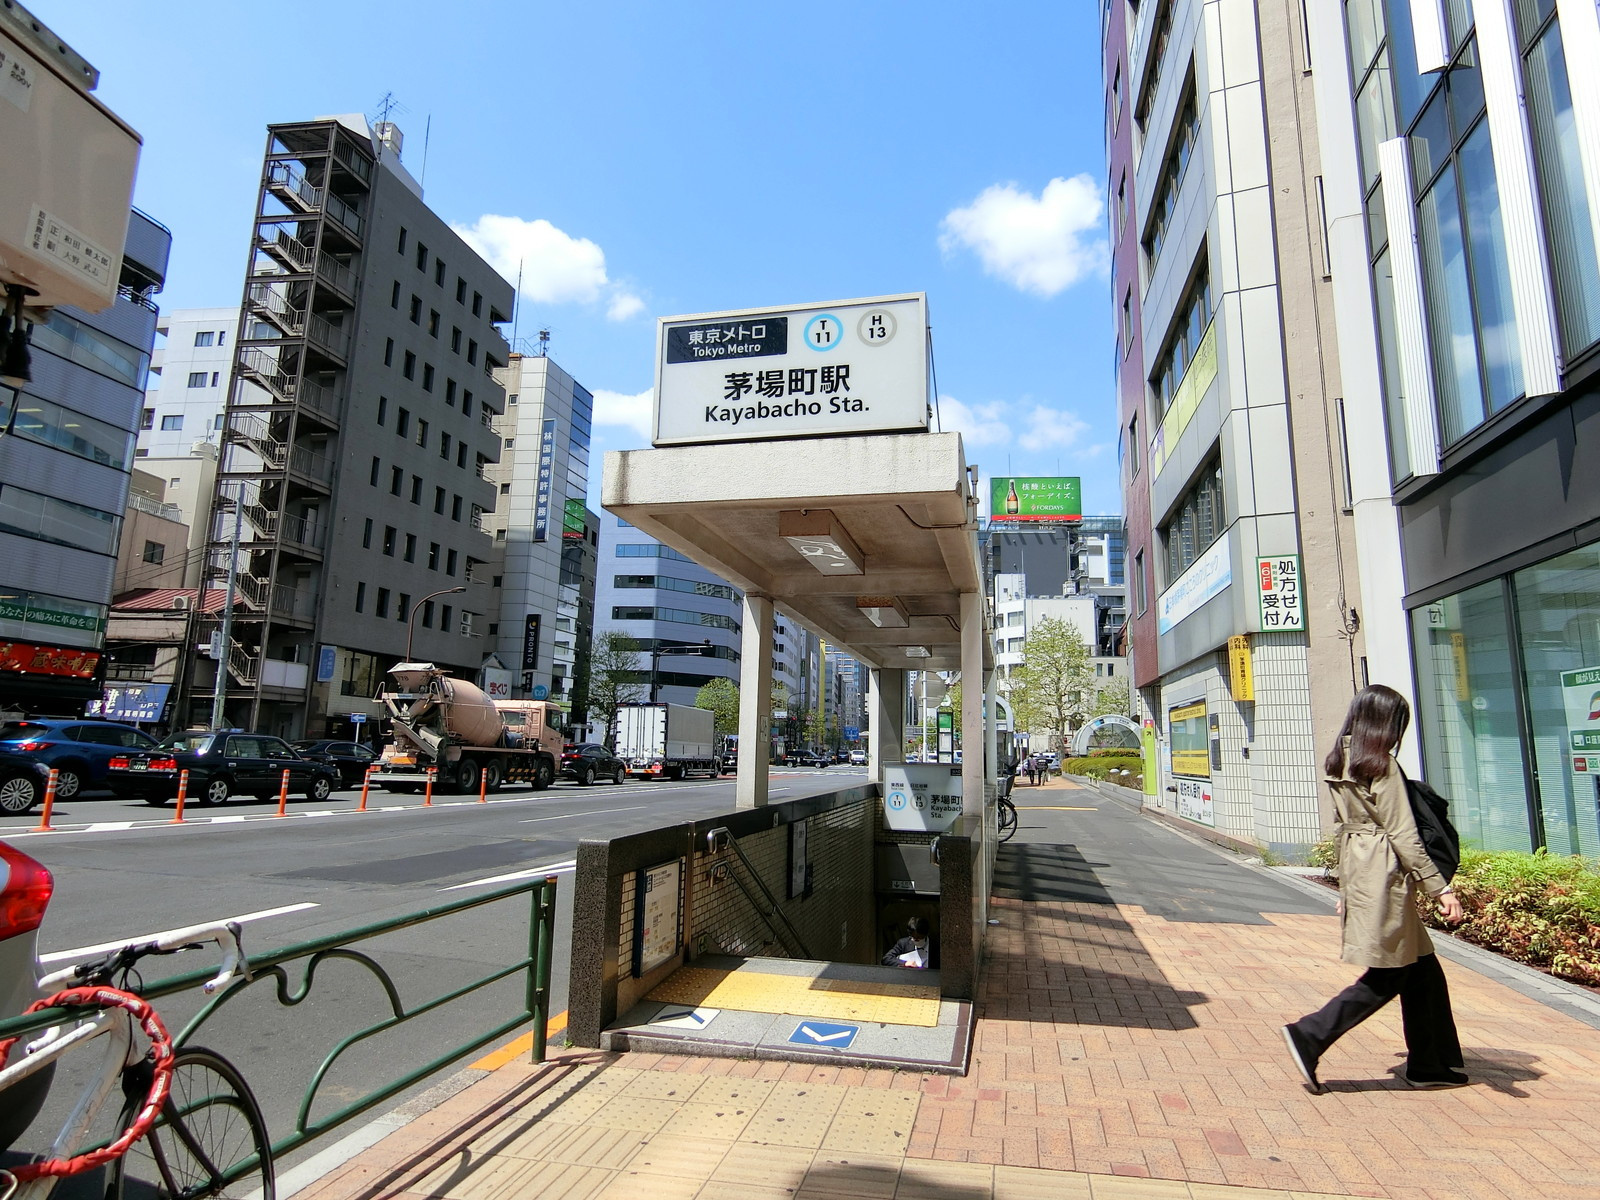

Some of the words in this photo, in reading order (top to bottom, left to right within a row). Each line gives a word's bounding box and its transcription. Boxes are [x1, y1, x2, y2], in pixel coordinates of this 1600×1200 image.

[50, 225, 60, 237] 正
[820, 320, 827, 330] T
[872, 315, 882, 326] H
[688, 324, 766, 345] 東京メトロ
[816, 332, 830, 343] 11
[869, 327, 886, 338] 13
[693, 346, 725, 358] Tokyo
[727, 343, 761, 354] Metro
[723, 364, 851, 401] 茅場町駅
[705, 399, 822, 425] Kayabacho
[829, 396, 870, 414] Sta.
[536, 431, 553, 530] 林国際特許事務所
[1261, 566, 1271, 586] 6F
[1279, 560, 1300, 626] 処方せん
[0, 605, 86, 627] あなたの痛みに革命を
[1262, 593, 1281, 626] 受付
[526, 631, 535, 664] PRONTO
[489, 681, 508, 695] 宝くじ
[930, 794, 963, 806] 茅場町
